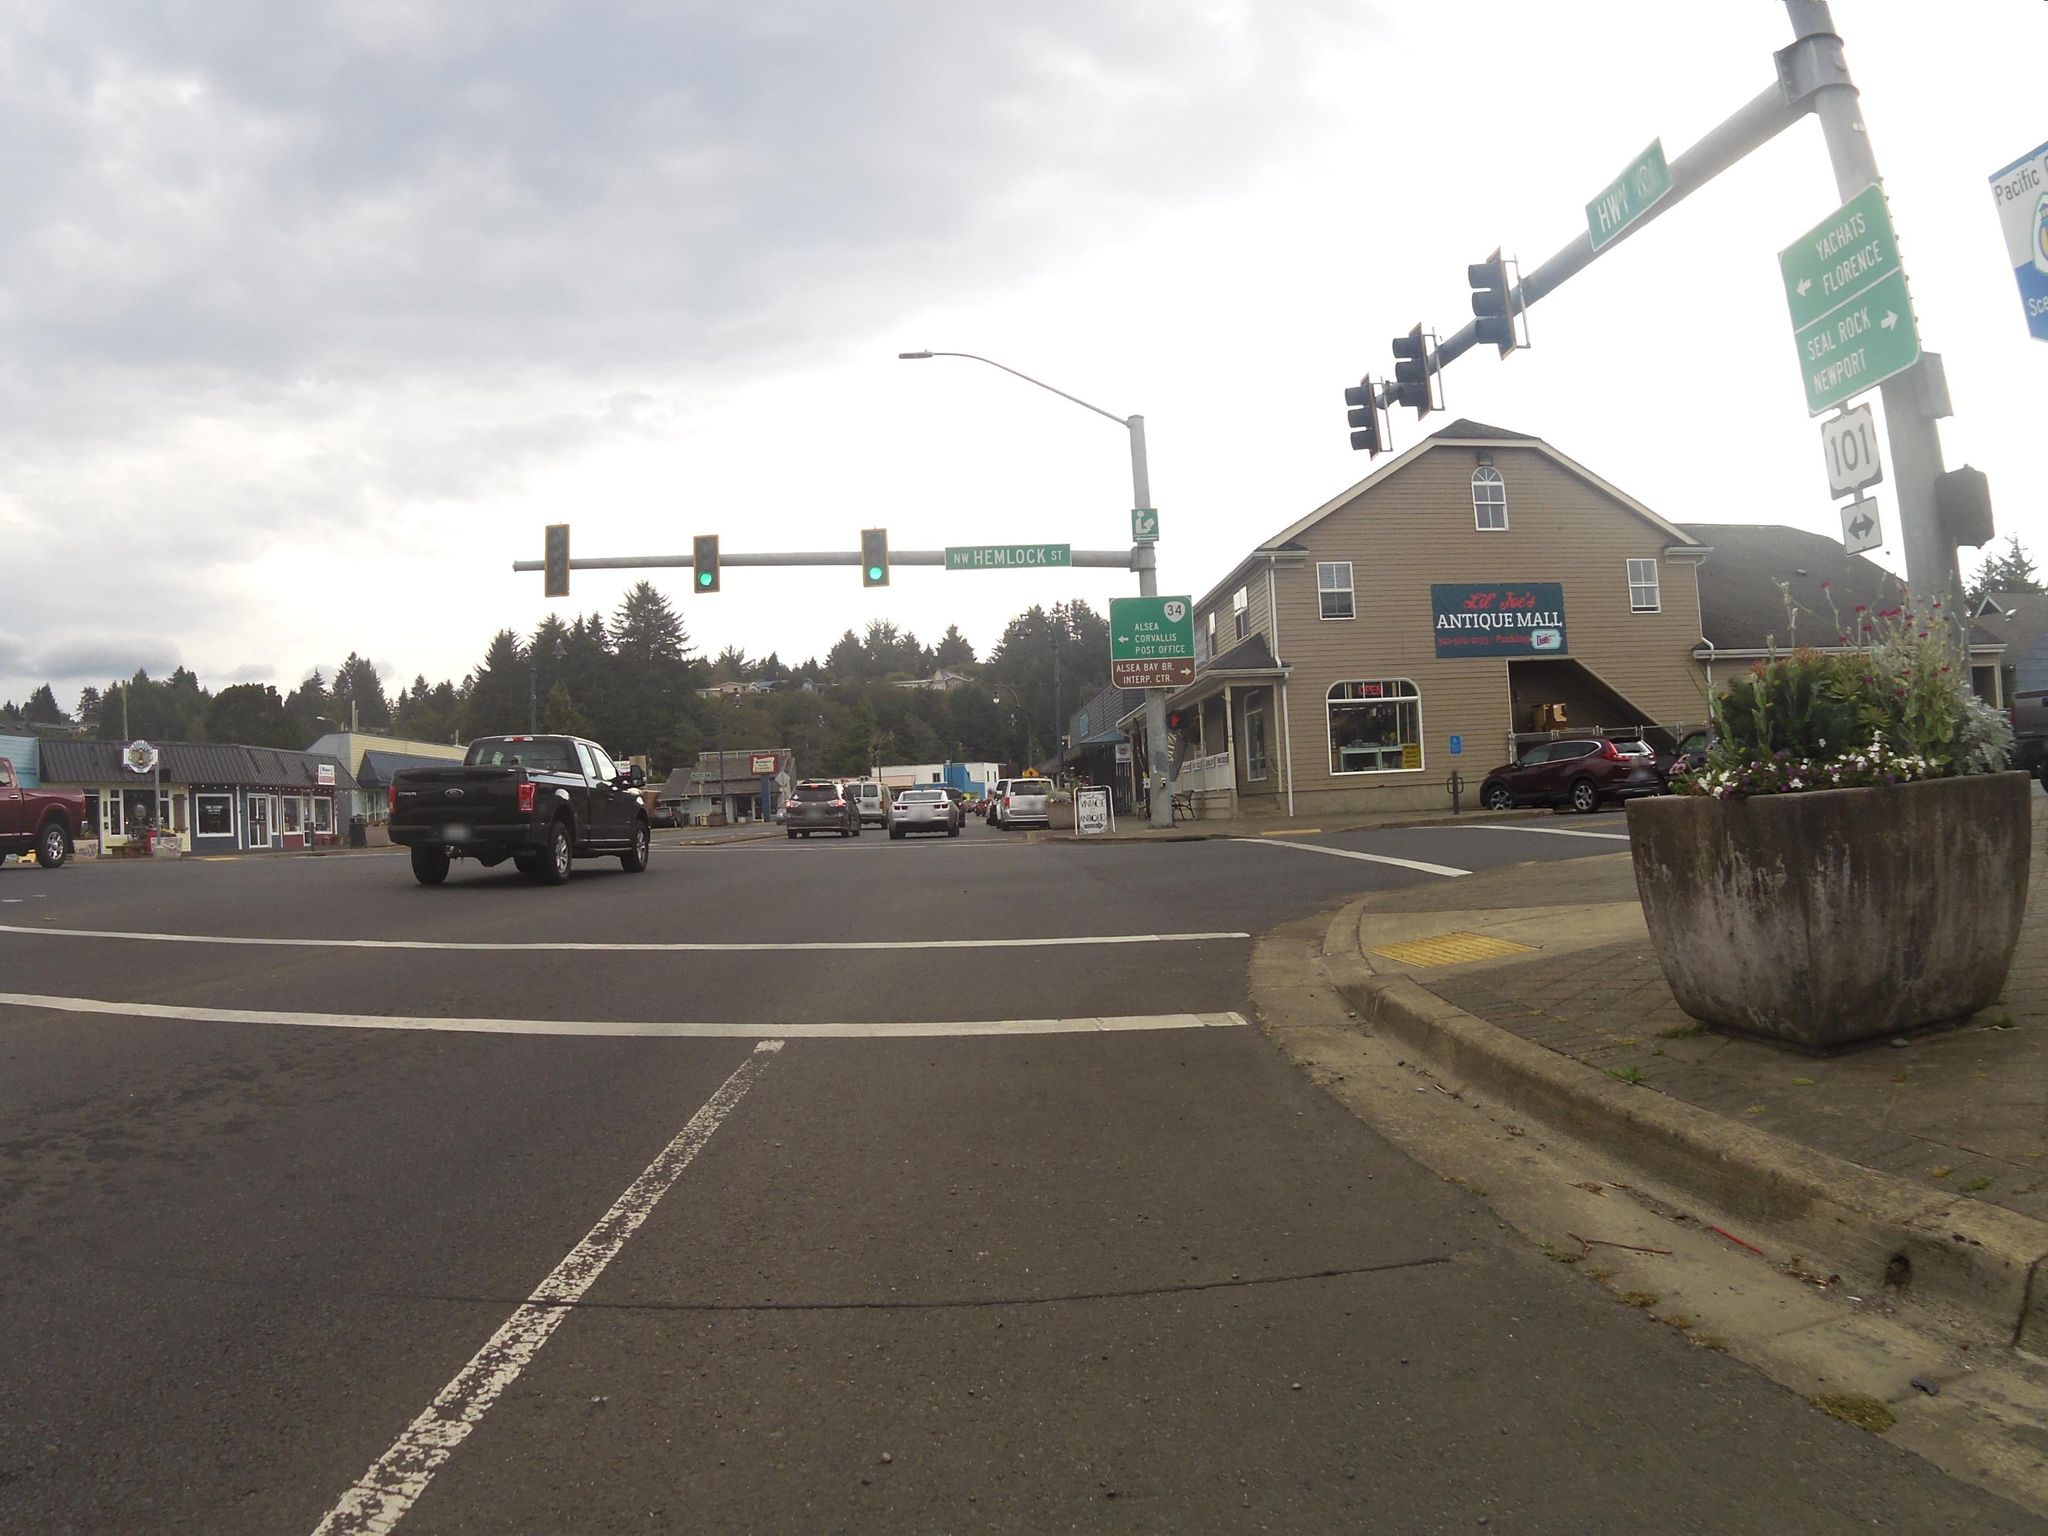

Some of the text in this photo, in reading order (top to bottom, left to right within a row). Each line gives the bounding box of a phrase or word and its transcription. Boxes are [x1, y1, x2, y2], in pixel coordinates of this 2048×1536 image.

[1994, 168, 2040, 206] Pacific
[1597, 183, 1630, 233] HWY
[1815, 213, 1866, 262] YACHATS
[1822, 240, 1884, 297] FLORENCE
[1807, 307, 1871, 361] SEAL ROCK
[1813, 348, 1867, 394] NEWPORT
[1830, 423, 1871, 477] 101
[953, 548, 1063, 566] NW HEMLOCK ST
[1167, 604, 1182, 616] 34
[1134, 622, 1160, 631] ALSEA
[1437, 611, 1563, 630] ANTIQUE MALL
[1134, 632, 1177, 643] CORVALLIS
[1135, 644, 1186, 655] POST OFFICE
[1116, 661, 1175, 673] ALSEA BAY BR.
[1123, 673, 1173, 684] INTERP. CTR.
